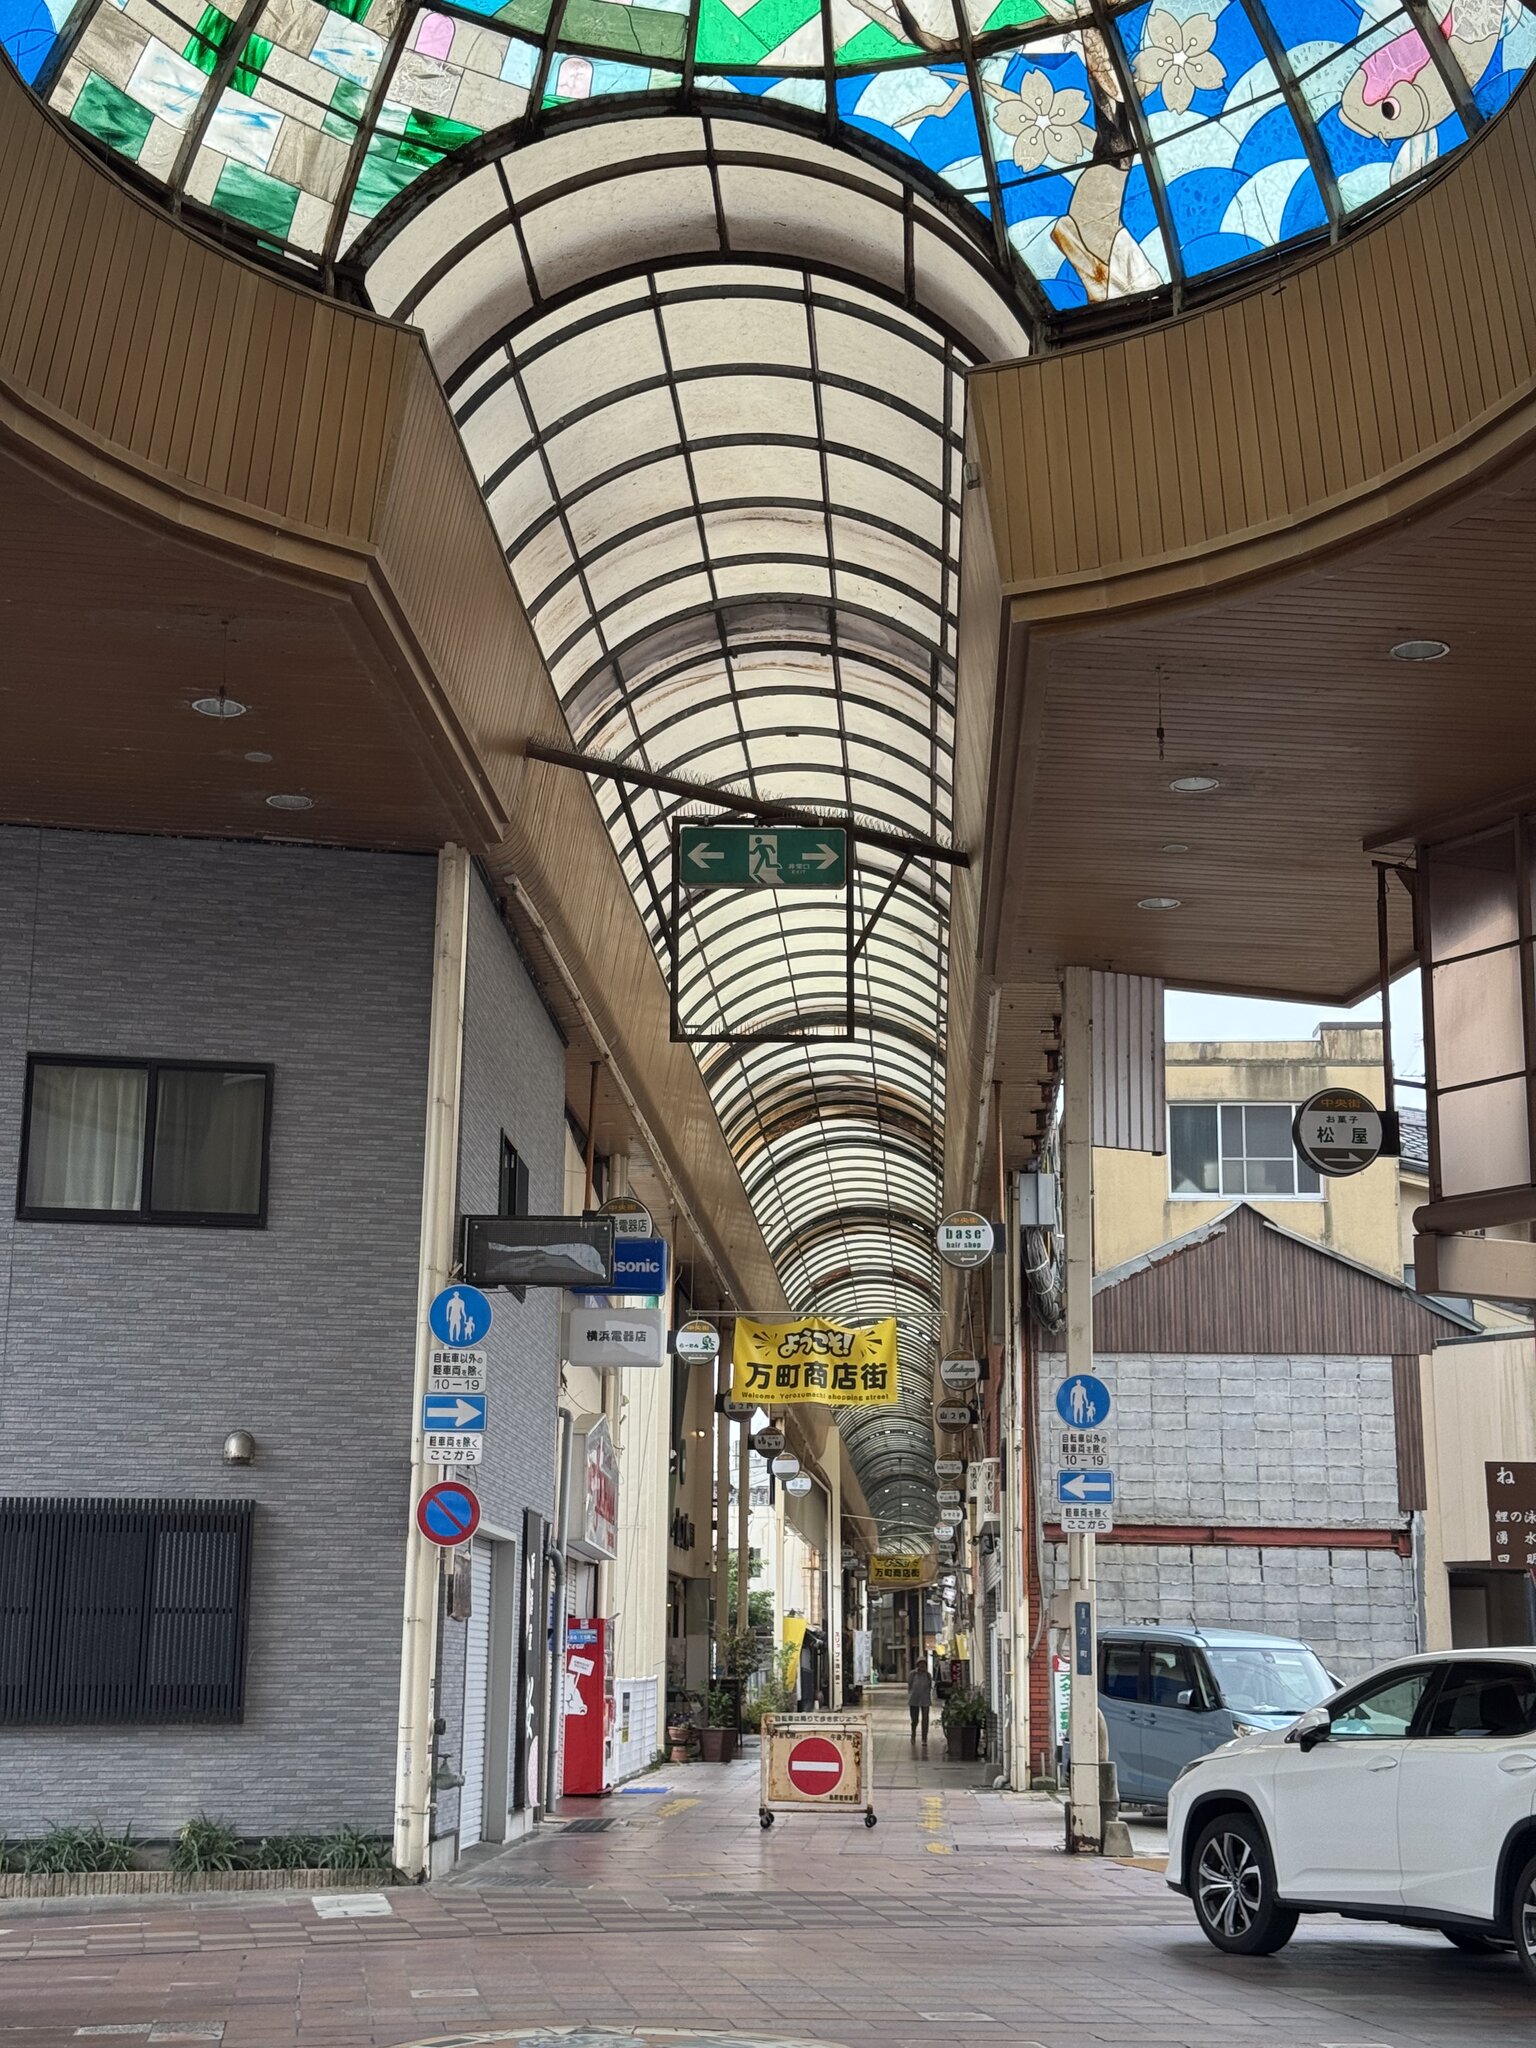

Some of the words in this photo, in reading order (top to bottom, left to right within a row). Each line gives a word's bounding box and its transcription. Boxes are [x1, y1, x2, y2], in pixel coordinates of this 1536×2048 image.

[1321, 1098, 1361, 1108] 中央街
[1326, 1115, 1359, 1124] お菓子
[1317, 1126, 1368, 1144] 松屋
[586, 1330, 646, 1342] 横浜電器店
[433, 1353, 483, 1363] 自転車以外の
[433, 1365, 482, 1376] 軽車両を除く
[745, 1361, 887, 1390] 万町商店街
[741, 1391, 775, 1400] Welcome
[779, 1391, 826, 1400] Yorozumachi
[866, 1393, 889, 1401] street
[429, 1436, 477, 1447] 軽車両を除く
[1062, 1434, 1107, 1443] 自転車以外の
[1062, 1444, 1106, 1453] 軽車両を除く
[430, 1451, 475, 1460] ここから
[1496, 1467, 1515, 1485] ね
[1065, 1508, 1107, 1517] 軽車両を除く
[1067, 1521, 1106, 1529] ここから
[875, 1568, 920, 1577] 万町商店街
